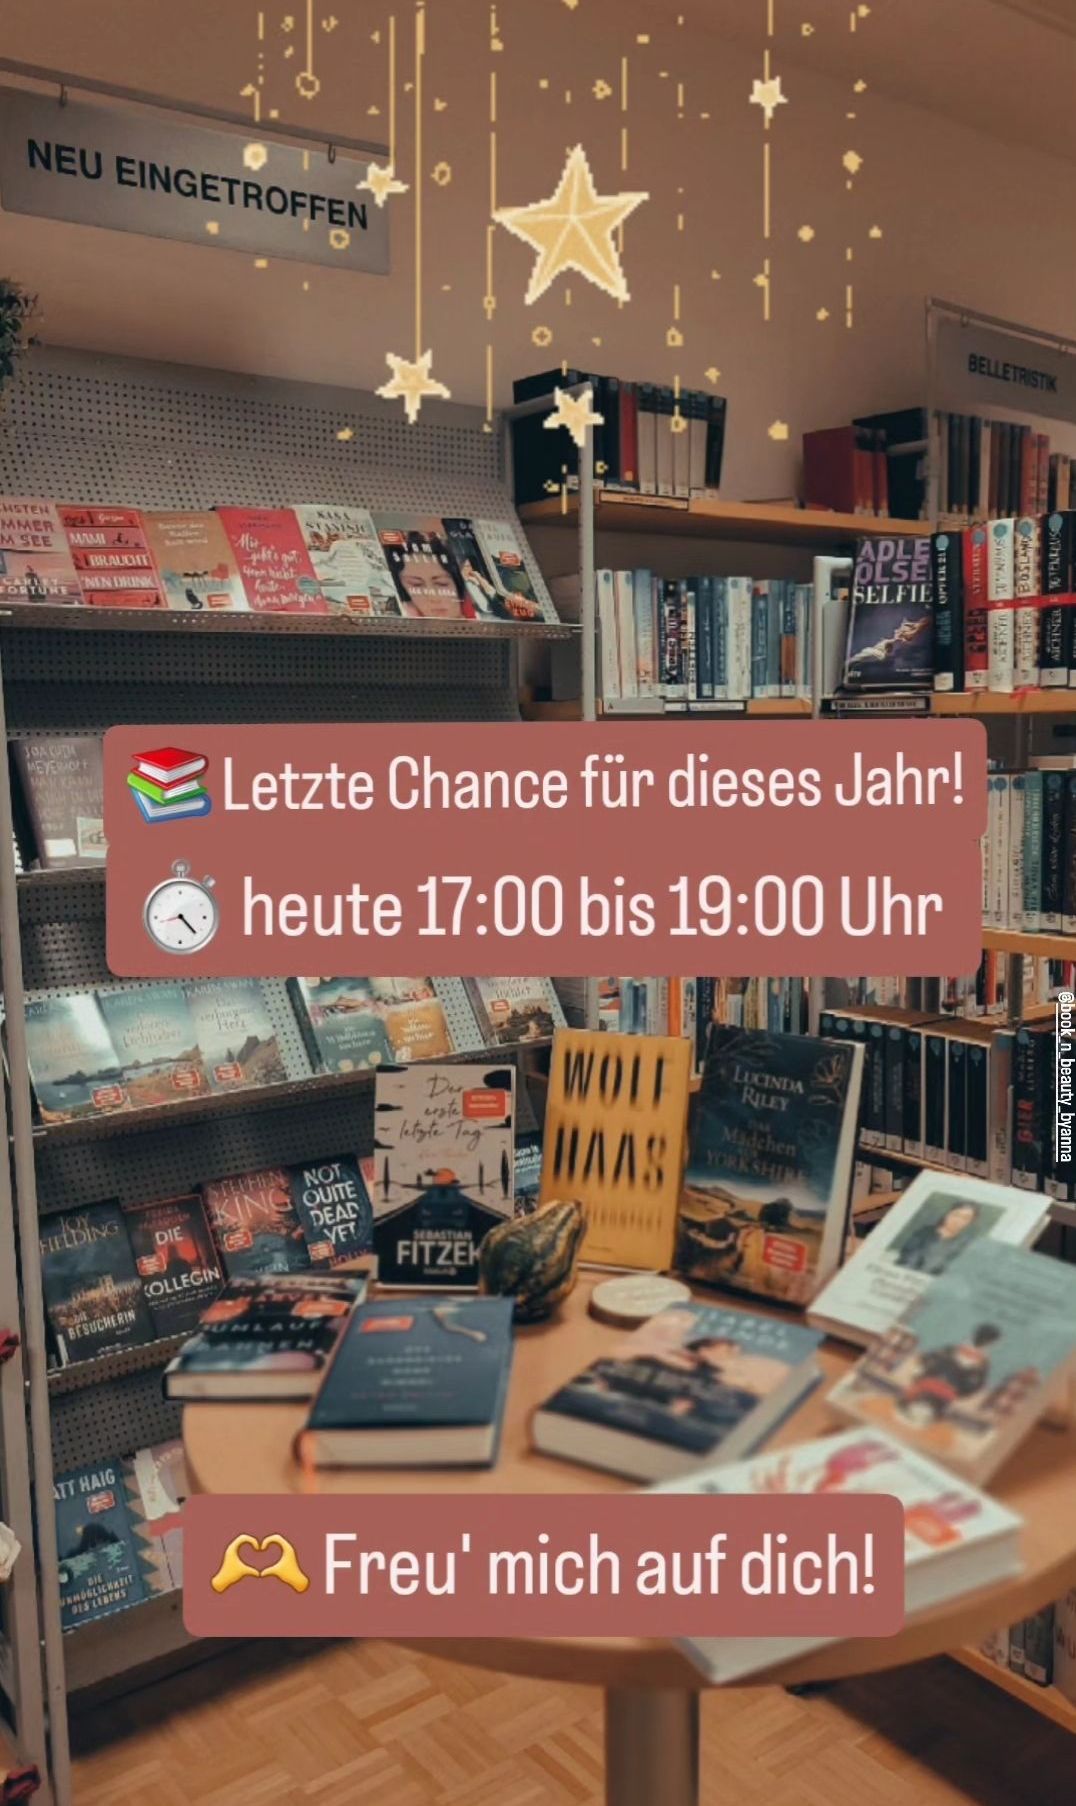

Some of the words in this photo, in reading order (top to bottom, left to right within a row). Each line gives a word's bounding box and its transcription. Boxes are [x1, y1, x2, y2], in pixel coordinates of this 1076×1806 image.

[27, 138, 103, 180] NEU
[115, 155, 368, 230] EINGETROFFEN
[968, 353, 1058, 393] BELLETRISTIK
[69, 532, 106, 546] MAMI
[856, 538, 931, 561] ADLE
[89, 554, 149, 567] BRAUCHT
[856, 559, 933, 584] OLSE
[853, 583, 933, 604] SELFIE
[734, 1065, 804, 1094] LUCINDA
[742, 1085, 790, 1112] RILEY
[1016, 1099, 1034, 1143] GIER
[303, 1163, 341, 1187] NOT
[302, 1180, 358, 1207] QUITE
[215, 1188, 293, 1226] KING
[310, 1201, 360, 1226] DEAD
[155, 1226, 184, 1246] DIE
[323, 1221, 357, 1244] YET
[413, 1229, 472, 1241] SEBASTIAN
[67, 1309, 136, 1341] BESUCHERIN
[79, 1468, 116, 1493] HAIG
